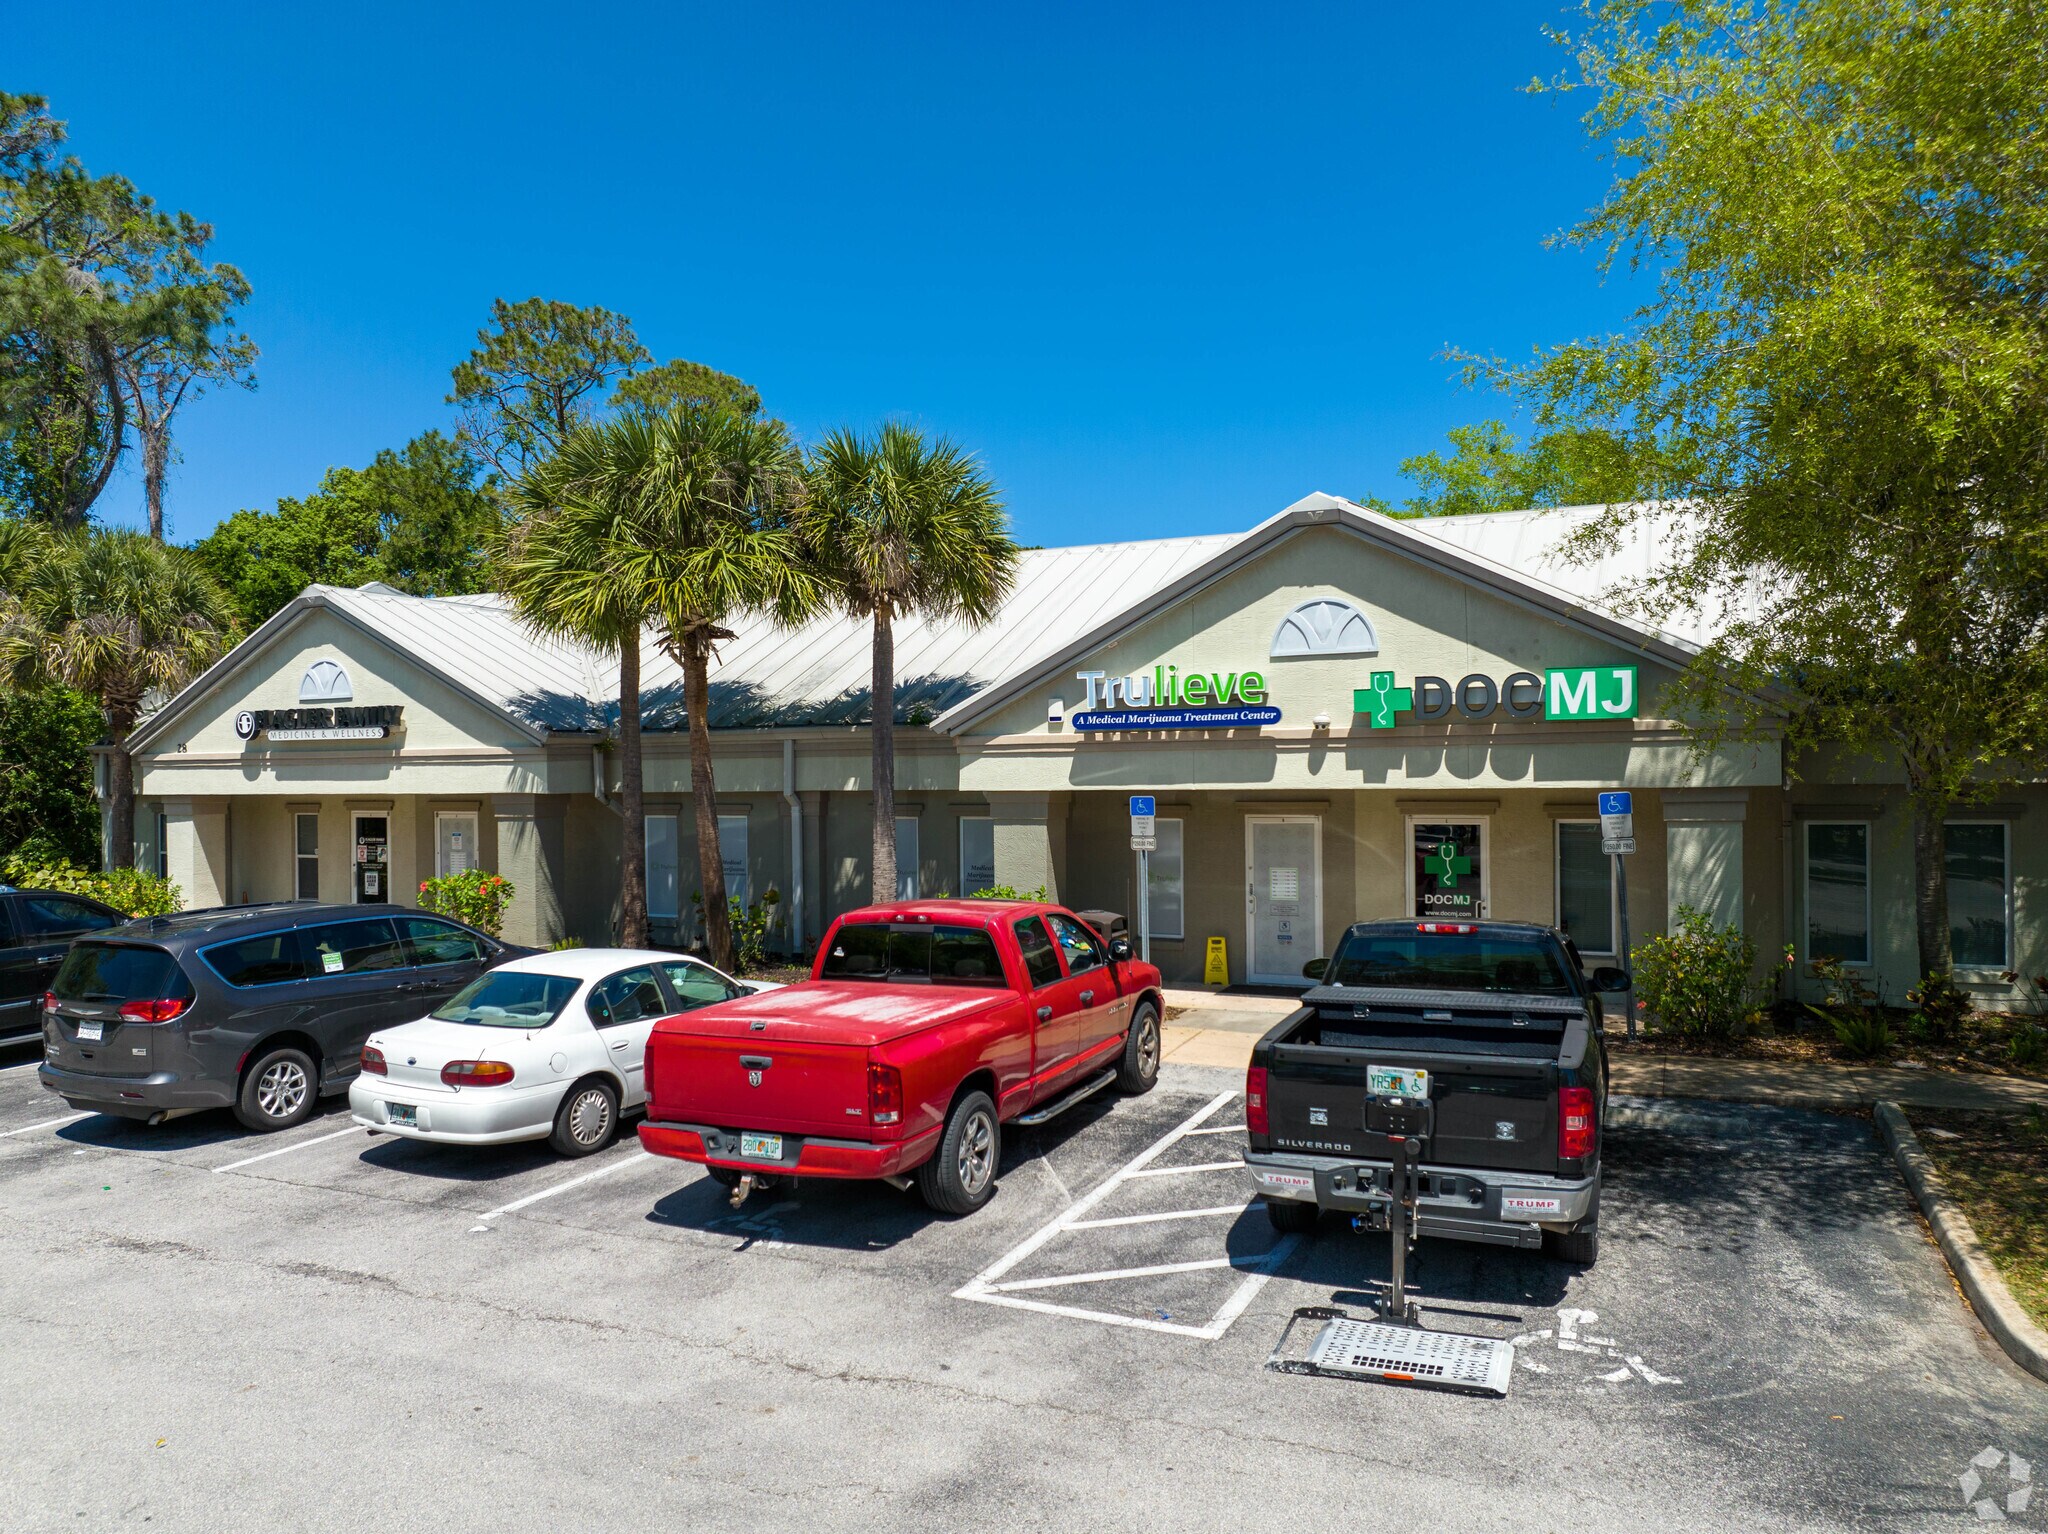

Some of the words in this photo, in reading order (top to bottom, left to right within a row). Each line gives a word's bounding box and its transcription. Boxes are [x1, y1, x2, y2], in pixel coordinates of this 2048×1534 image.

[1077, 665, 1265, 709] Trulieve
[1414, 669, 1633, 720] DOCMJ
[254, 708, 334, 730] FLAGLER
[334, 705, 405, 728] FAMILY
[1077, 717, 1085, 725] A
[1087, 714, 1127, 725] Medical
[1128, 713, 1182, 725] Marijuana
[1183, 711, 1239, 723] Treatment
[1240, 710, 1277, 721] Center
[270, 730, 316, 739] MEDICINE
[321, 730, 328, 739] &
[332, 728, 383, 738] WELLNESS
[1623, 842, 1633, 850] FINE
[1424, 894, 1471, 905] DOCMJ
[1425, 910, 1472, 918] www.docmj.com
[1277, 1138, 1352, 1152] SILVERADO
[1268, 1175, 1310, 1185] TRUMP
[1508, 1200, 1555, 1208] TRUMP
